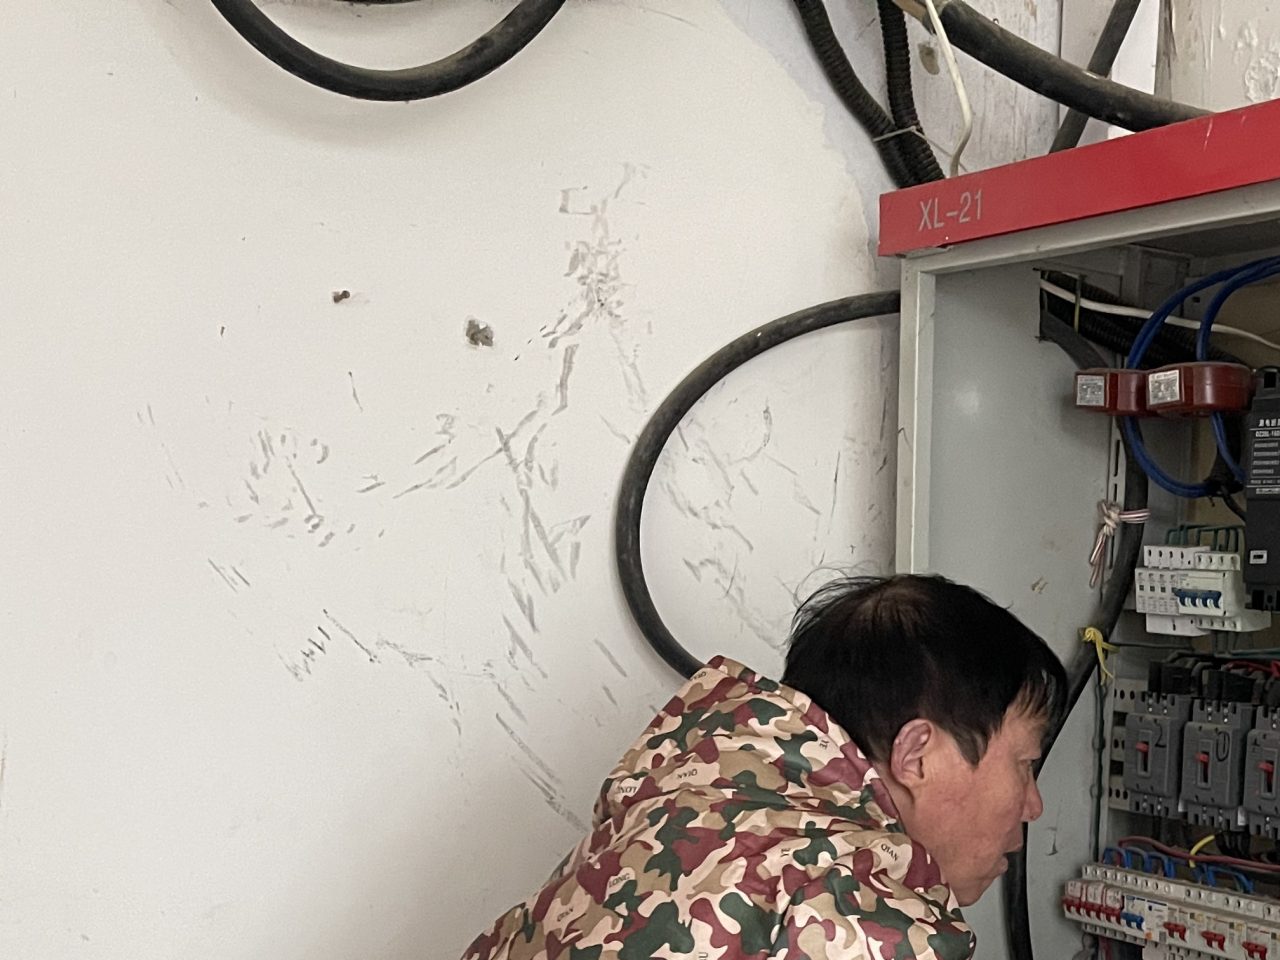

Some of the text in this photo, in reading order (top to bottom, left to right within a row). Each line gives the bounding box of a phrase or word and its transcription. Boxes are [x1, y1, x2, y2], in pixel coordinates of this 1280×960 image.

[917, 191, 985, 231] XL-21
[1154, 725, 1167, 749] 2
[880, 843, 898, 861] QIAN
[608, 872, 630, 888] LONG
